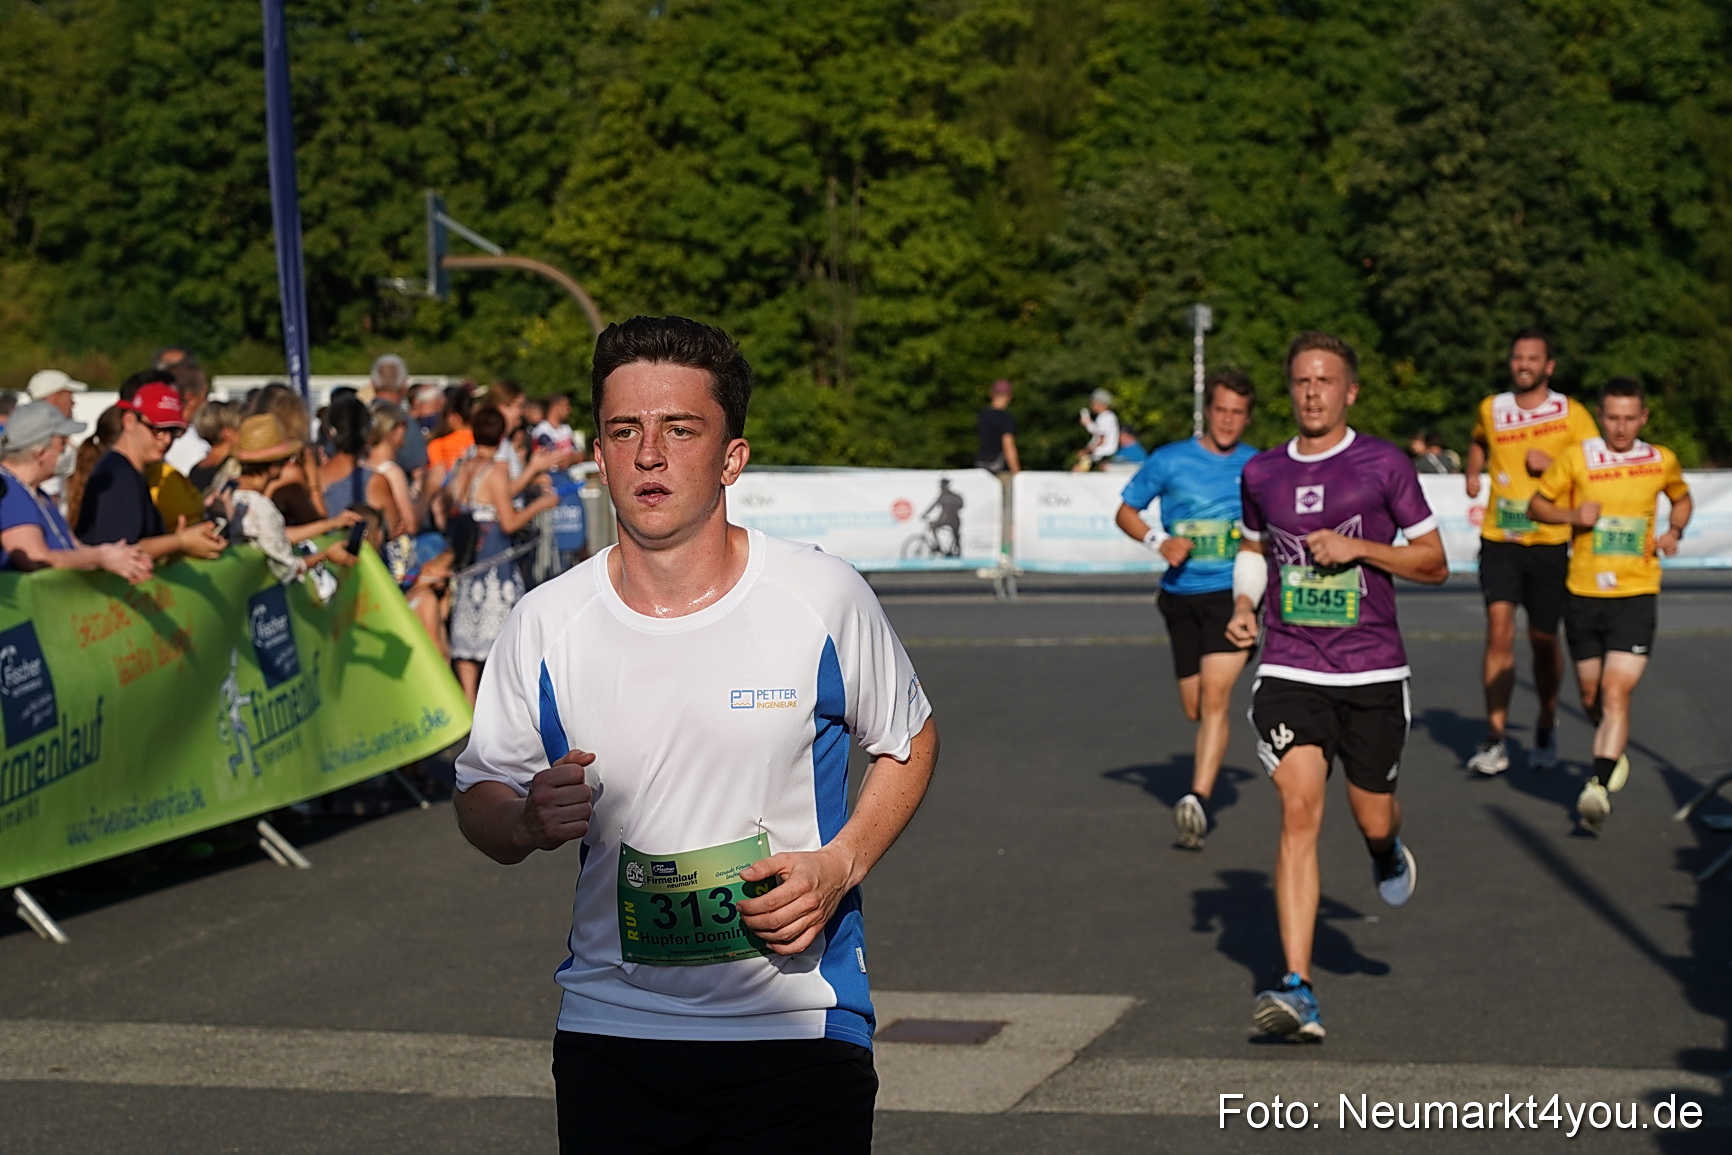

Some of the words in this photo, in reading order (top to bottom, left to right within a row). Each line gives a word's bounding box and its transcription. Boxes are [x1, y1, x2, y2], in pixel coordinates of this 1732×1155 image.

[1295, 587, 1346, 607] 1545
[757, 689, 797, 700] PETTER
[756, 700, 797, 709] INGENIEURE
[646, 870, 698, 885] Firmenlauf
[666, 879, 698, 889] neumarkt
[650, 886, 738, 930] 313
[624, 900, 640, 942] RUN
[639, 931, 690, 947] Hupfer
